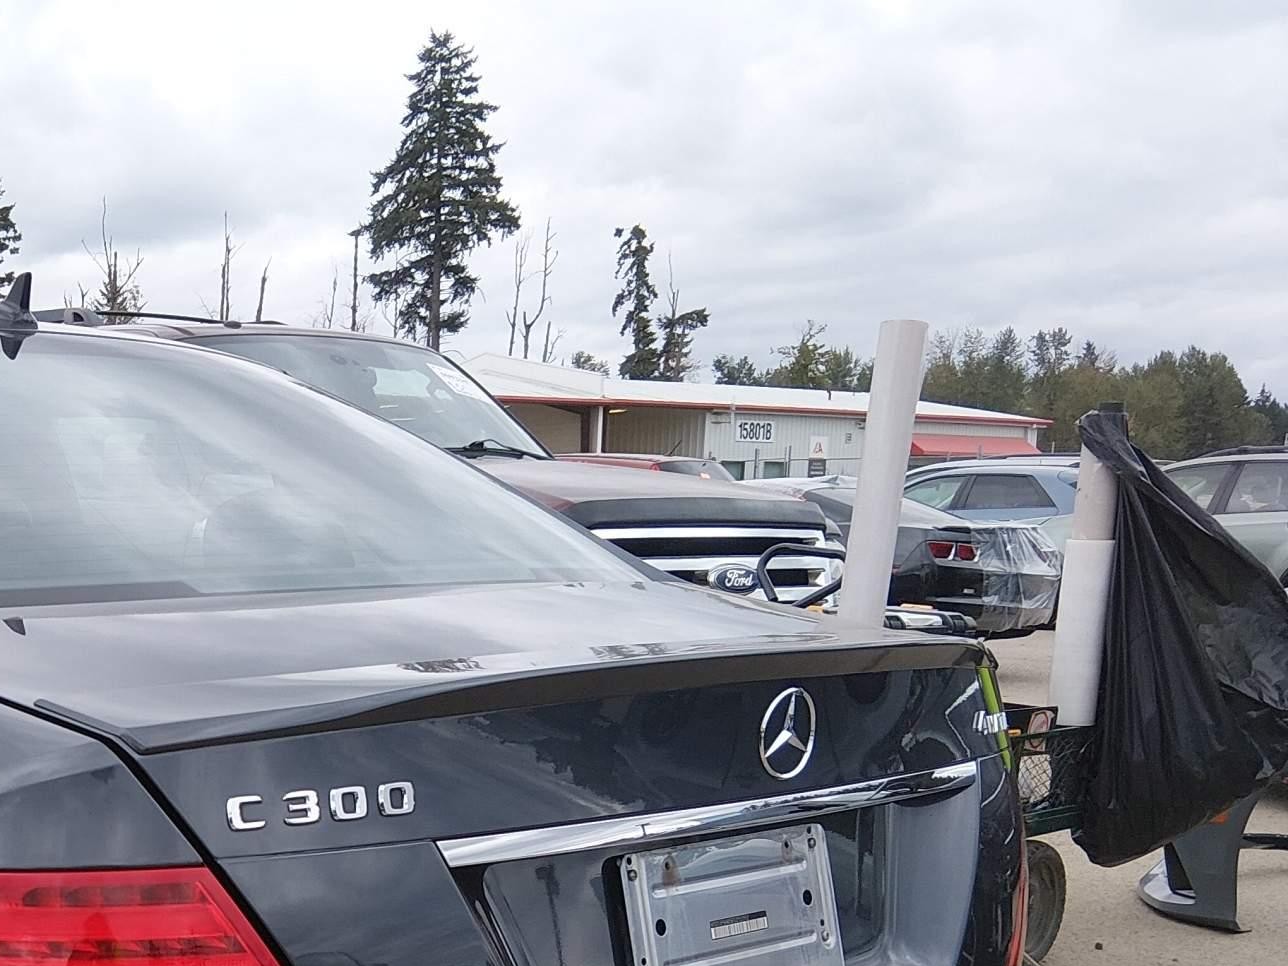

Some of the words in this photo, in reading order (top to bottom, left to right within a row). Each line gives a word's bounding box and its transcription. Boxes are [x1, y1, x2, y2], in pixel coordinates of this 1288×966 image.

[738, 422, 772, 440] 15801B
[725, 569, 754, 587] Ford
[226, 795, 266, 831] C
[282, 781, 415, 825] 300
